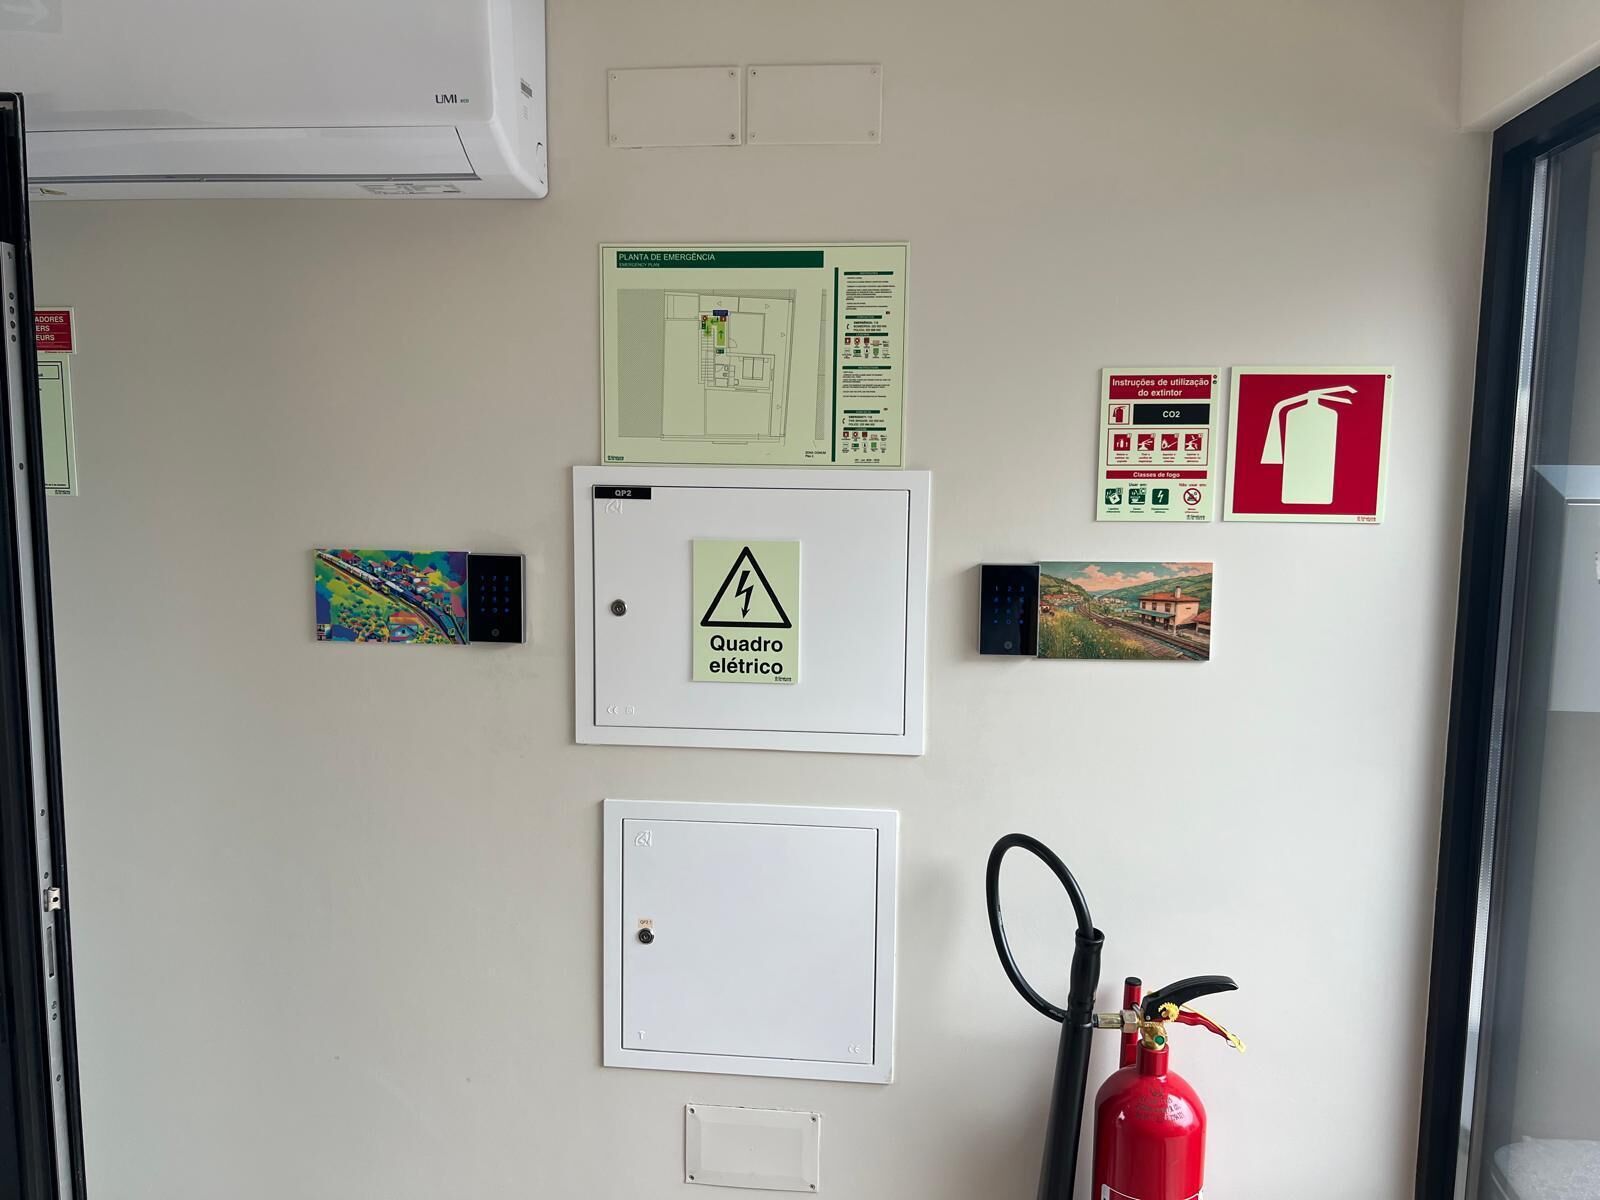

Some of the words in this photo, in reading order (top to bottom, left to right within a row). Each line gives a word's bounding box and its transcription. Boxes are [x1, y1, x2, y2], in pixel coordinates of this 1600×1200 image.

[435, 94, 457, 104] UMI
[618, 253, 649, 261] PLANTA
[650, 253, 662, 261] DE
[663, 252, 716, 261] EMERGÊNCIA
[1112, 378, 1156, 388] Instruções
[1157, 378, 1168, 386] de
[1170, 377, 1209, 388] utilização
[1137, 389, 1149, 397] do
[1150, 388, 1183, 397] extintor
[1162, 410, 1181, 418] CO2
[1166, 471, 1181, 479] fogo
[614, 489, 632, 497] QP2
[710, 634, 783, 653] Quadro
[709, 657, 784, 675] elétrico
